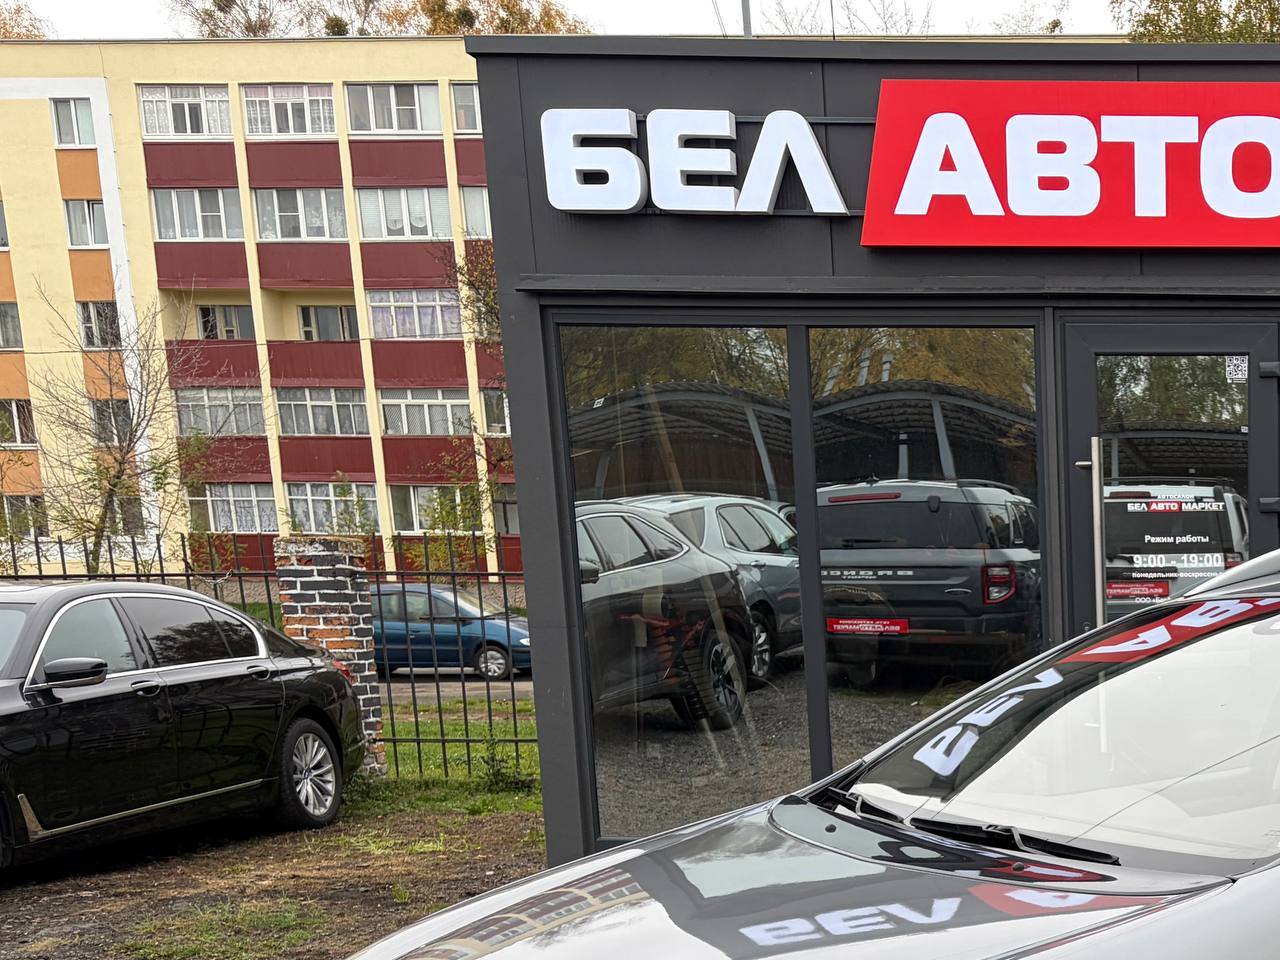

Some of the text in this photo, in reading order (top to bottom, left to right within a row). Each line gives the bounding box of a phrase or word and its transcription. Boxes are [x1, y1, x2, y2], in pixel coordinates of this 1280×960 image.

[540, 108, 850, 216] БЕЛ
[1127, 503, 1148, 511] БЕЛ
[1182, 502, 1225, 510] МАРКЕТ
[1144, 534, 1209, 544] Режим работы
[1133, 554, 1166, 567] 9:00
[1181, 553, 1222, 568] 19:00
